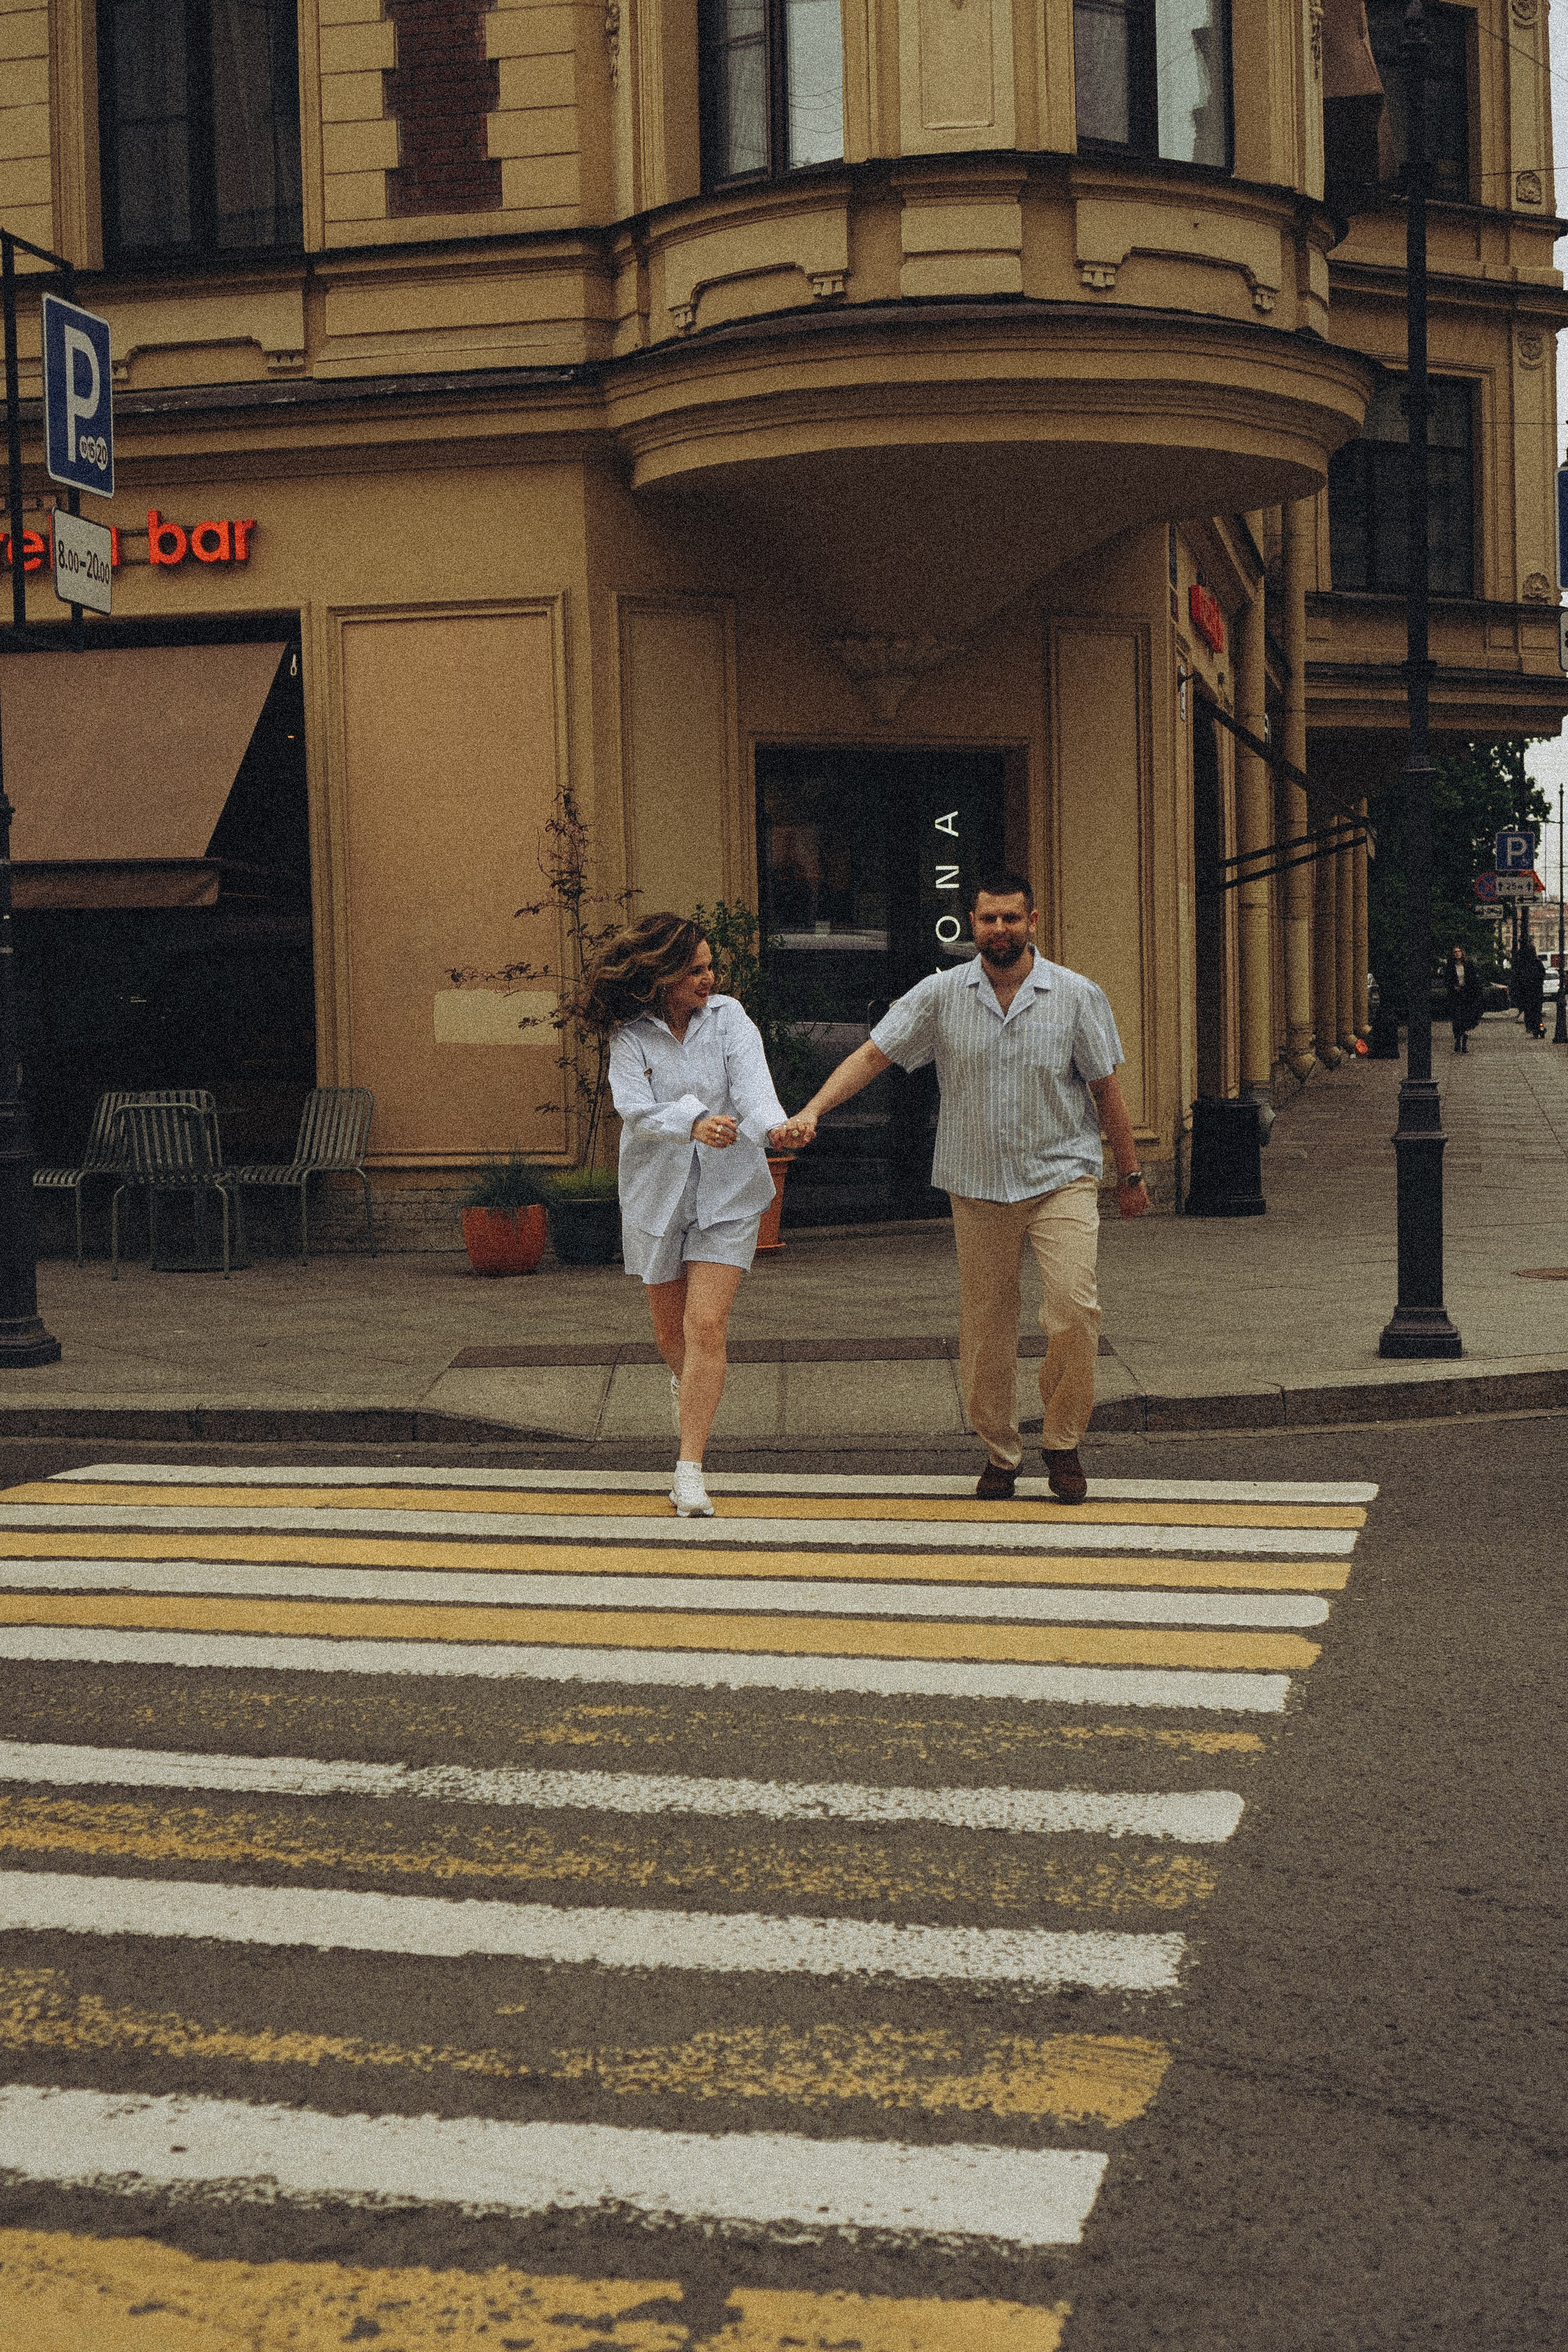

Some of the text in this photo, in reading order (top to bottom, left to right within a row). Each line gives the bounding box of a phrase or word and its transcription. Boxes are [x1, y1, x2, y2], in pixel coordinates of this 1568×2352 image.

[64, 324, 100, 462] P
[88, 442, 96, 459] 15
[97, 443, 107, 464] 20
[148, 510, 255, 564] bar
[58, 540, 110, 585] 8.00-20.00
[1507, 837, 1528, 866] P
[935, 810, 960, 974] ONA
